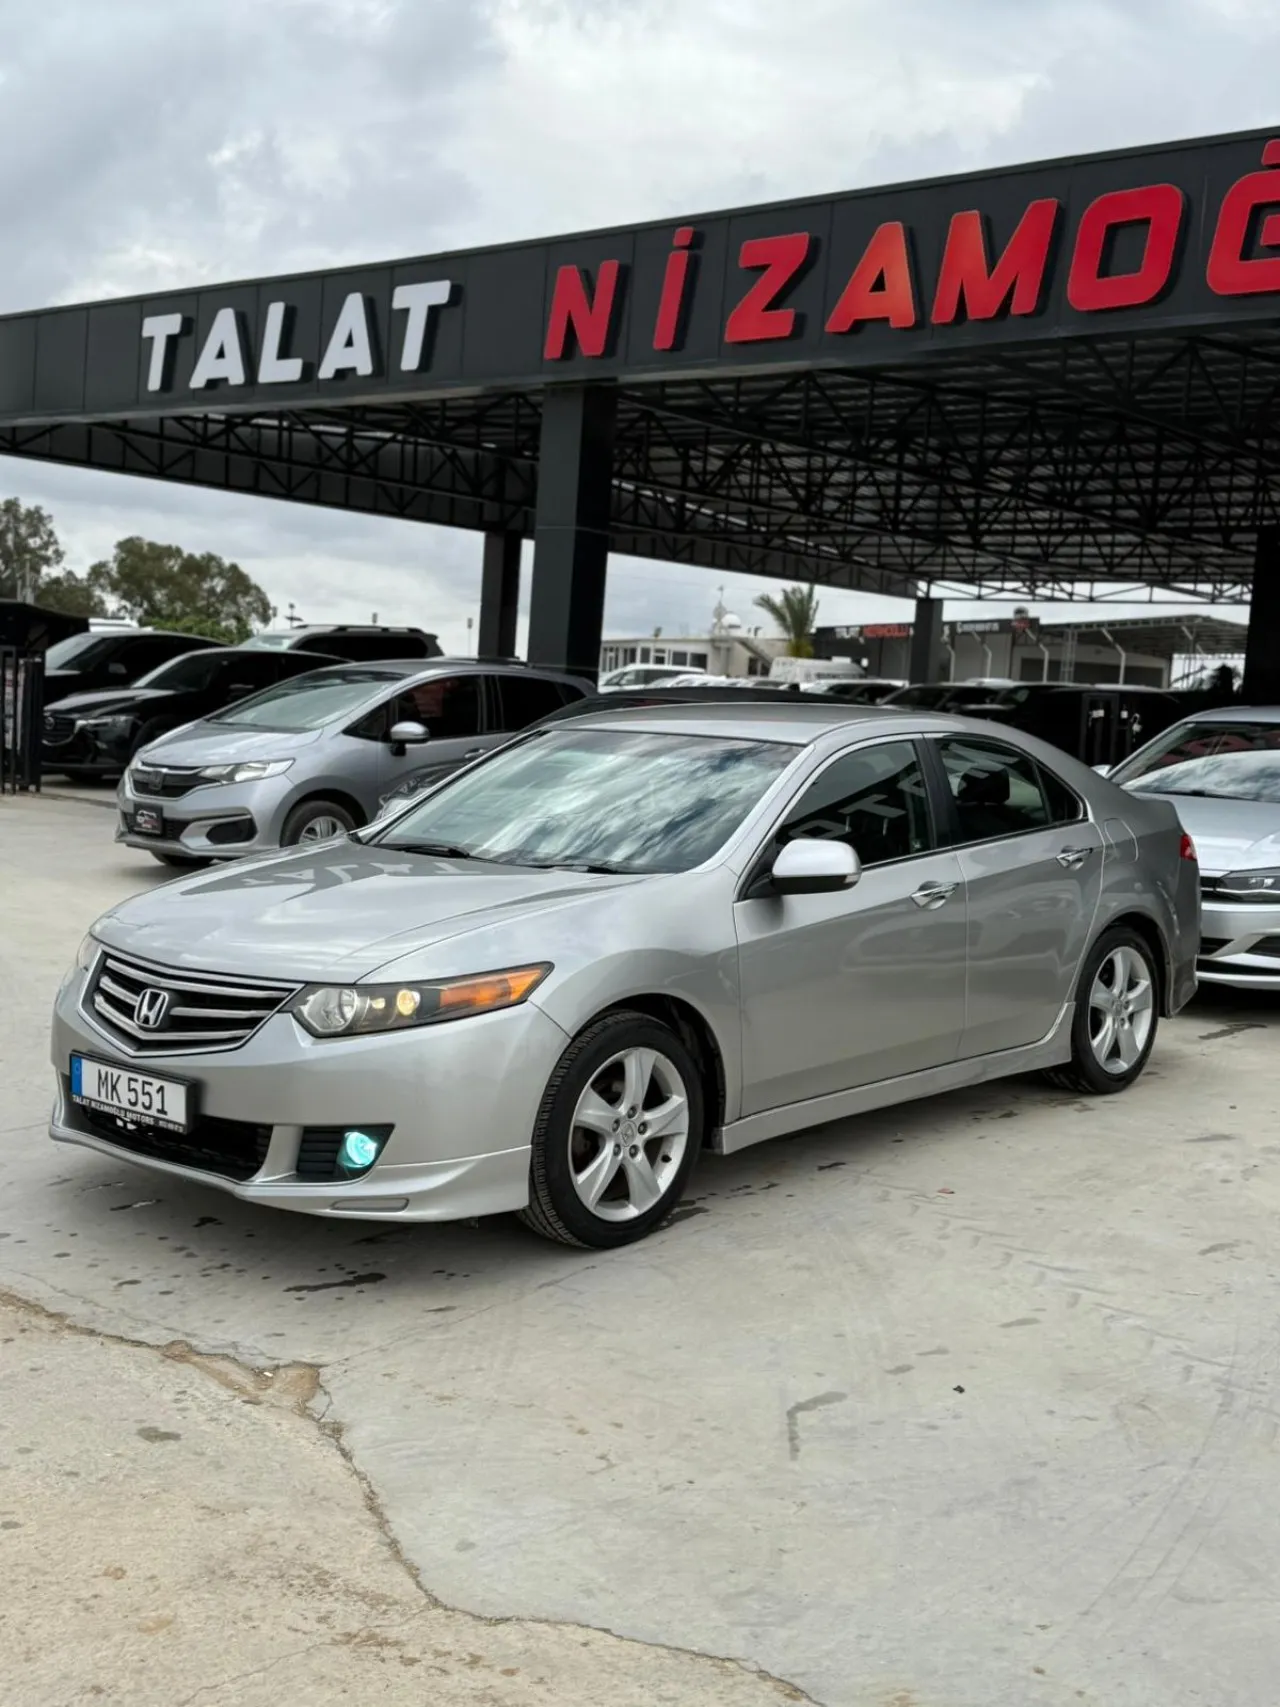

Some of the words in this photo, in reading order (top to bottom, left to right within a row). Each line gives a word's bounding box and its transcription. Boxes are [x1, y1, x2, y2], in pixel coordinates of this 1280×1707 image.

[142, 281, 451, 392] TALAT
[98, 1068, 122, 1104] MK
[127, 1076, 168, 1116] 551
